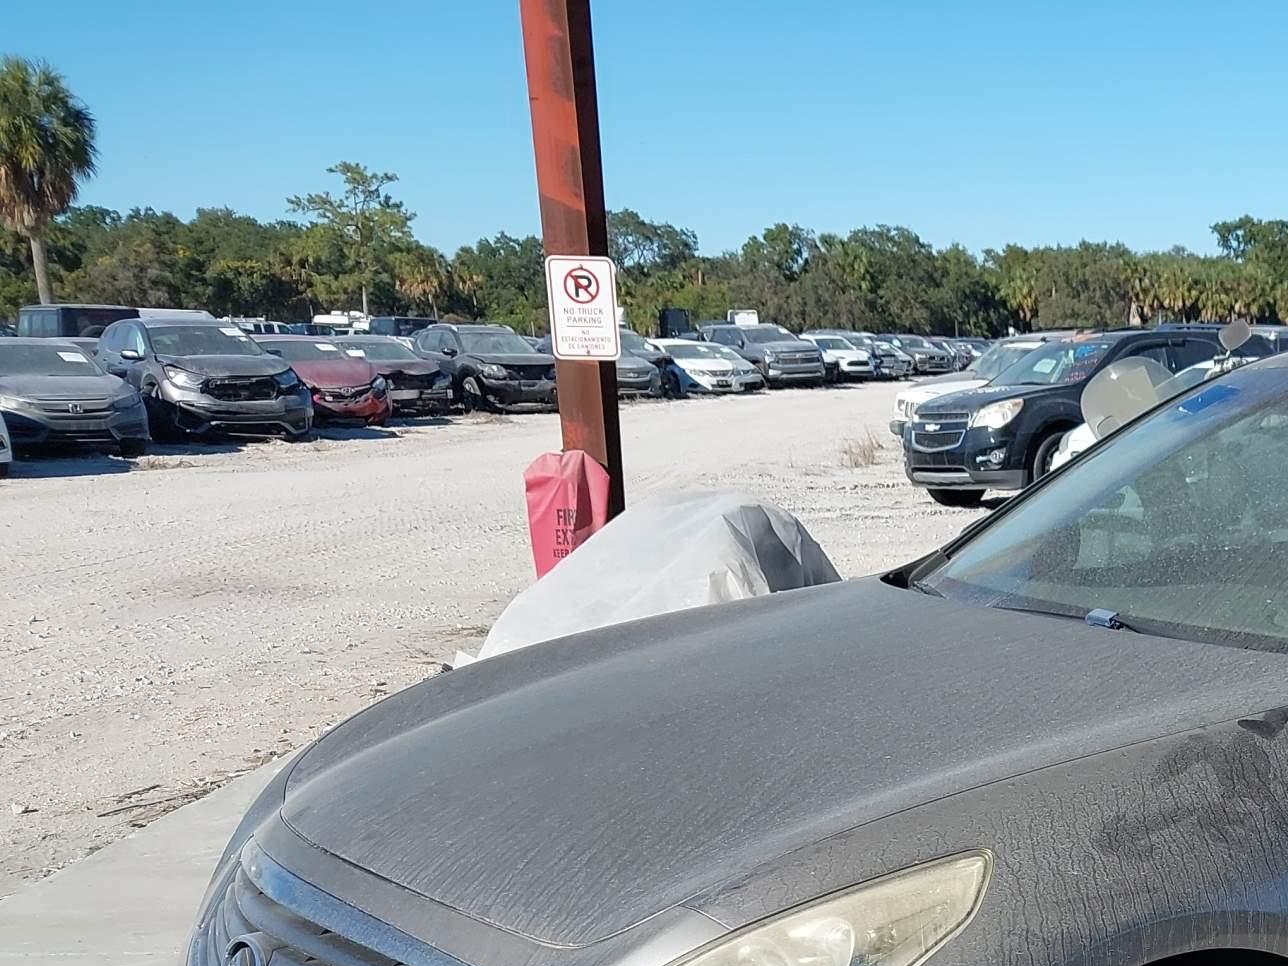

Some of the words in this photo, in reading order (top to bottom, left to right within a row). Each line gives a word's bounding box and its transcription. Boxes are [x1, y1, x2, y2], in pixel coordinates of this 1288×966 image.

[563, 307, 575, 315] NO
[577, 307, 604, 315] TRUCK
[566, 316, 602, 324] PARKING
